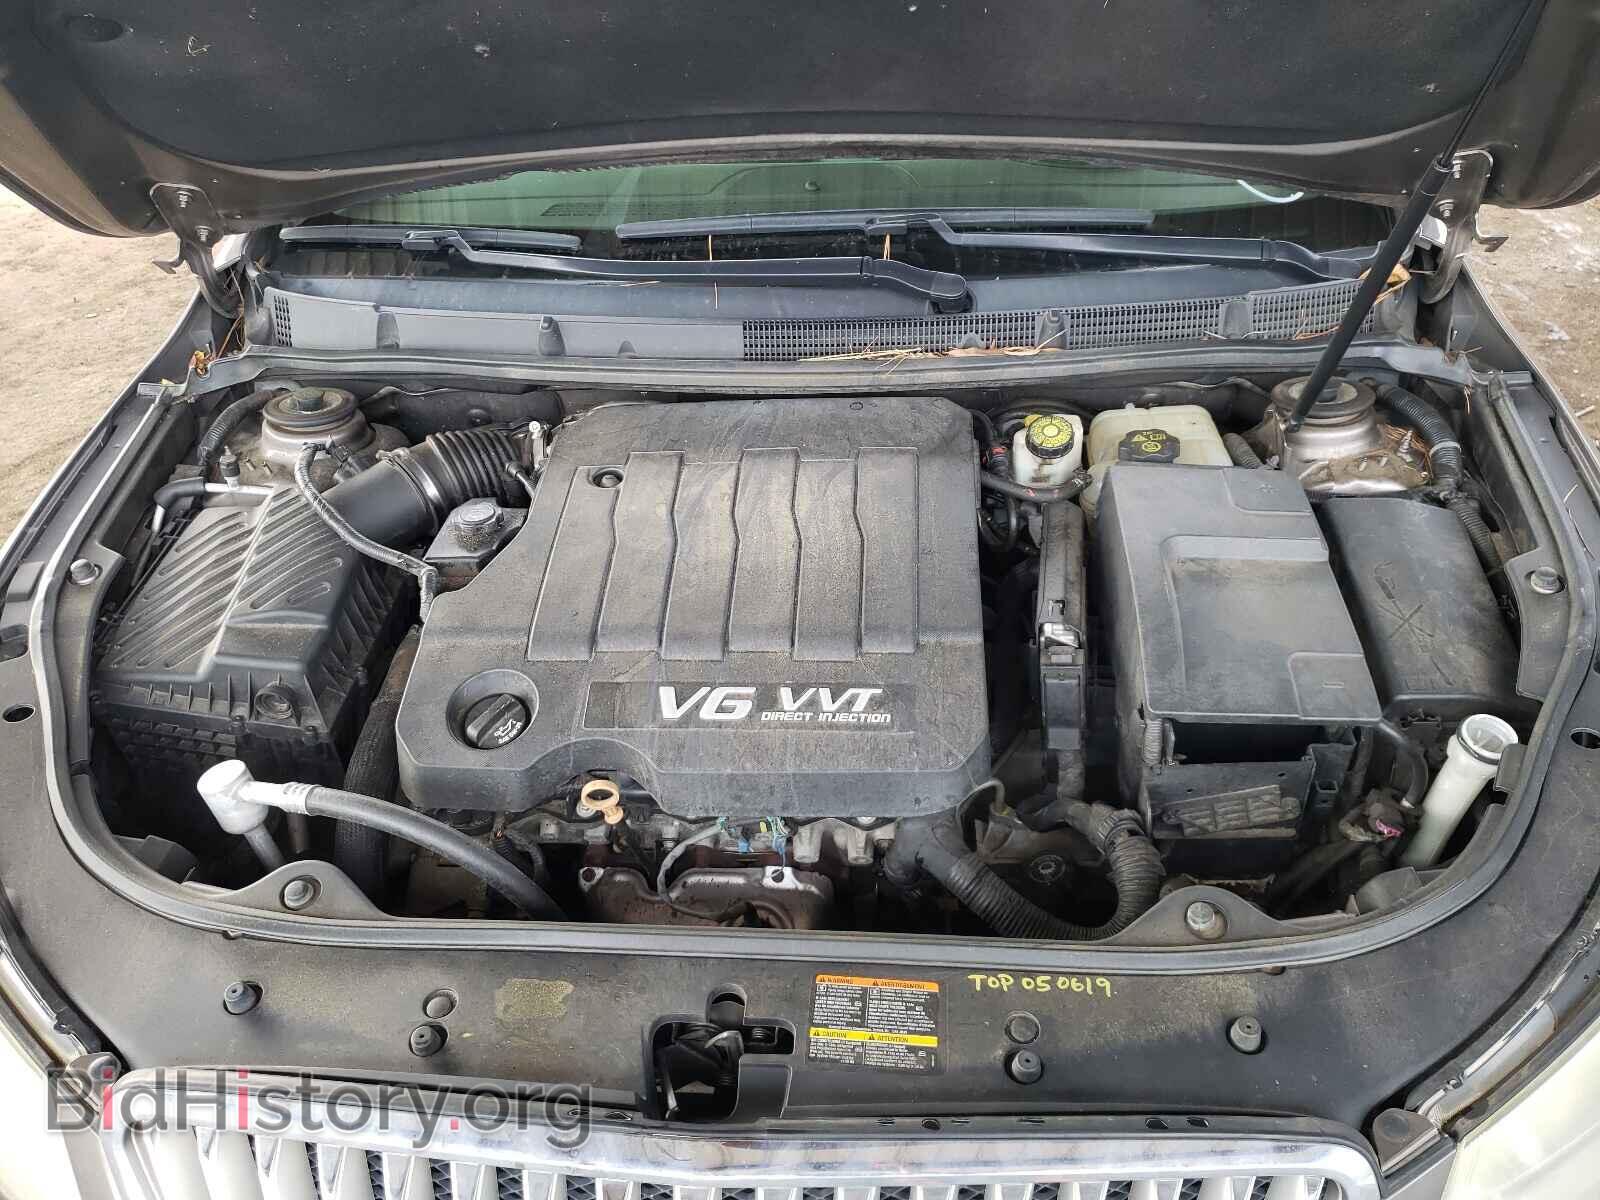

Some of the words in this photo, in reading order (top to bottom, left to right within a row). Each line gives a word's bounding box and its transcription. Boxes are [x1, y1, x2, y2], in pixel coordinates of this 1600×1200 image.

[659, 686, 757, 720] V6
[780, 687, 883, 712] VVT
[761, 711, 813, 722] DIRECT
[817, 712, 891, 723] INJECTION
[827, 977, 854, 985] WARNING
[968, 974, 1014, 992] TOP
[822, 1031, 847, 1039] CAUTION
